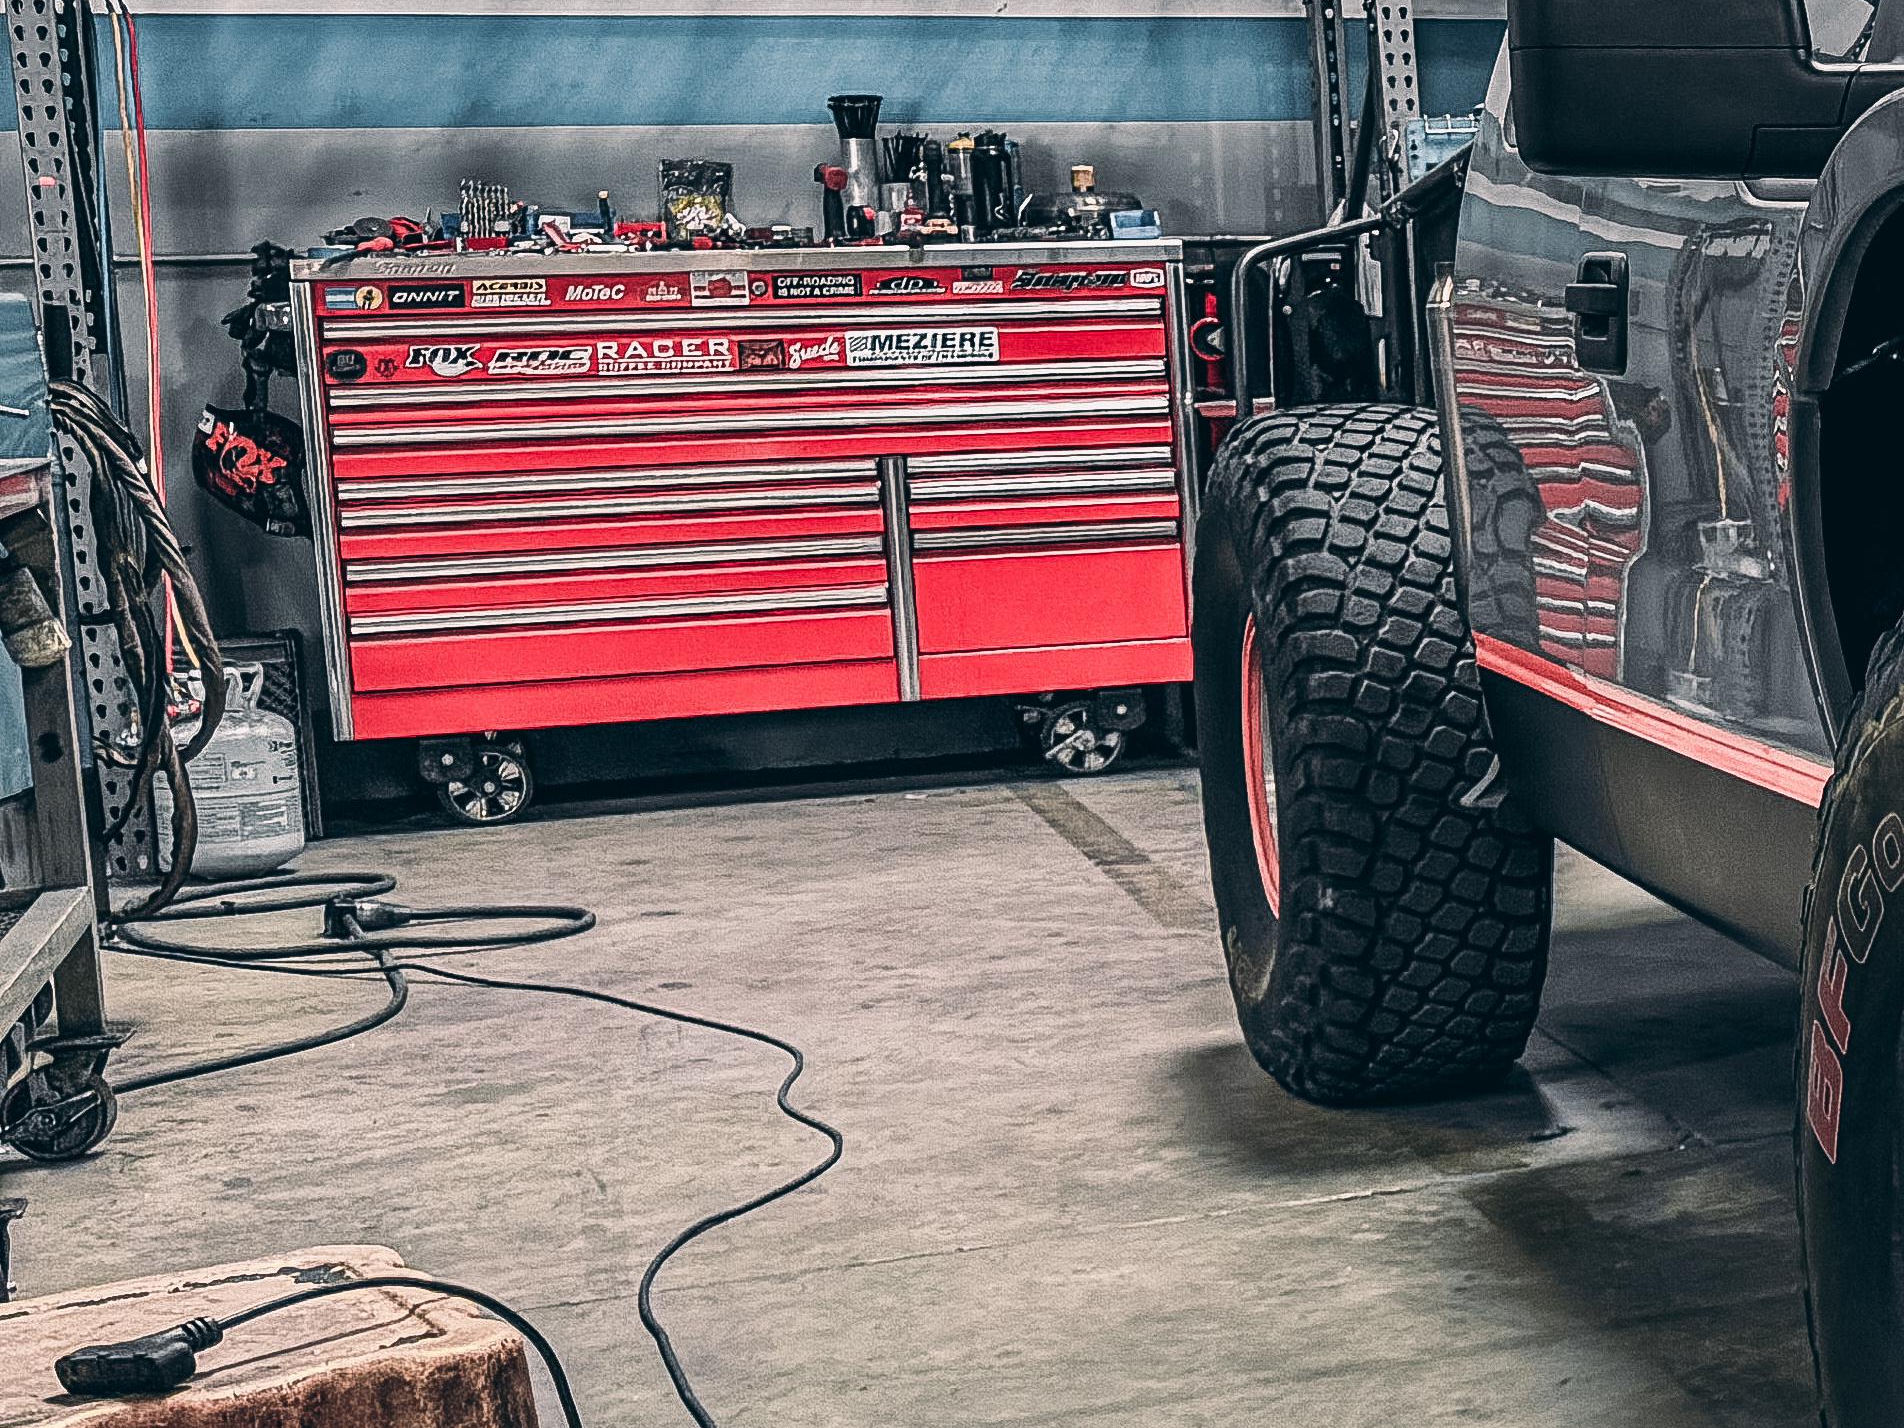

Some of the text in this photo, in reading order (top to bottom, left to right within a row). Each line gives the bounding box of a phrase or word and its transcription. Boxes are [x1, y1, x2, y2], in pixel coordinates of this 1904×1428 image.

[392, 290, 461, 304] ONNIT
[565, 284, 625, 301] MoTeC
[813, 287, 821, 296] A
[596, 338, 731, 360] RACER
[869, 331, 995, 352] MEZIERE
[408, 345, 482, 371] FOX
